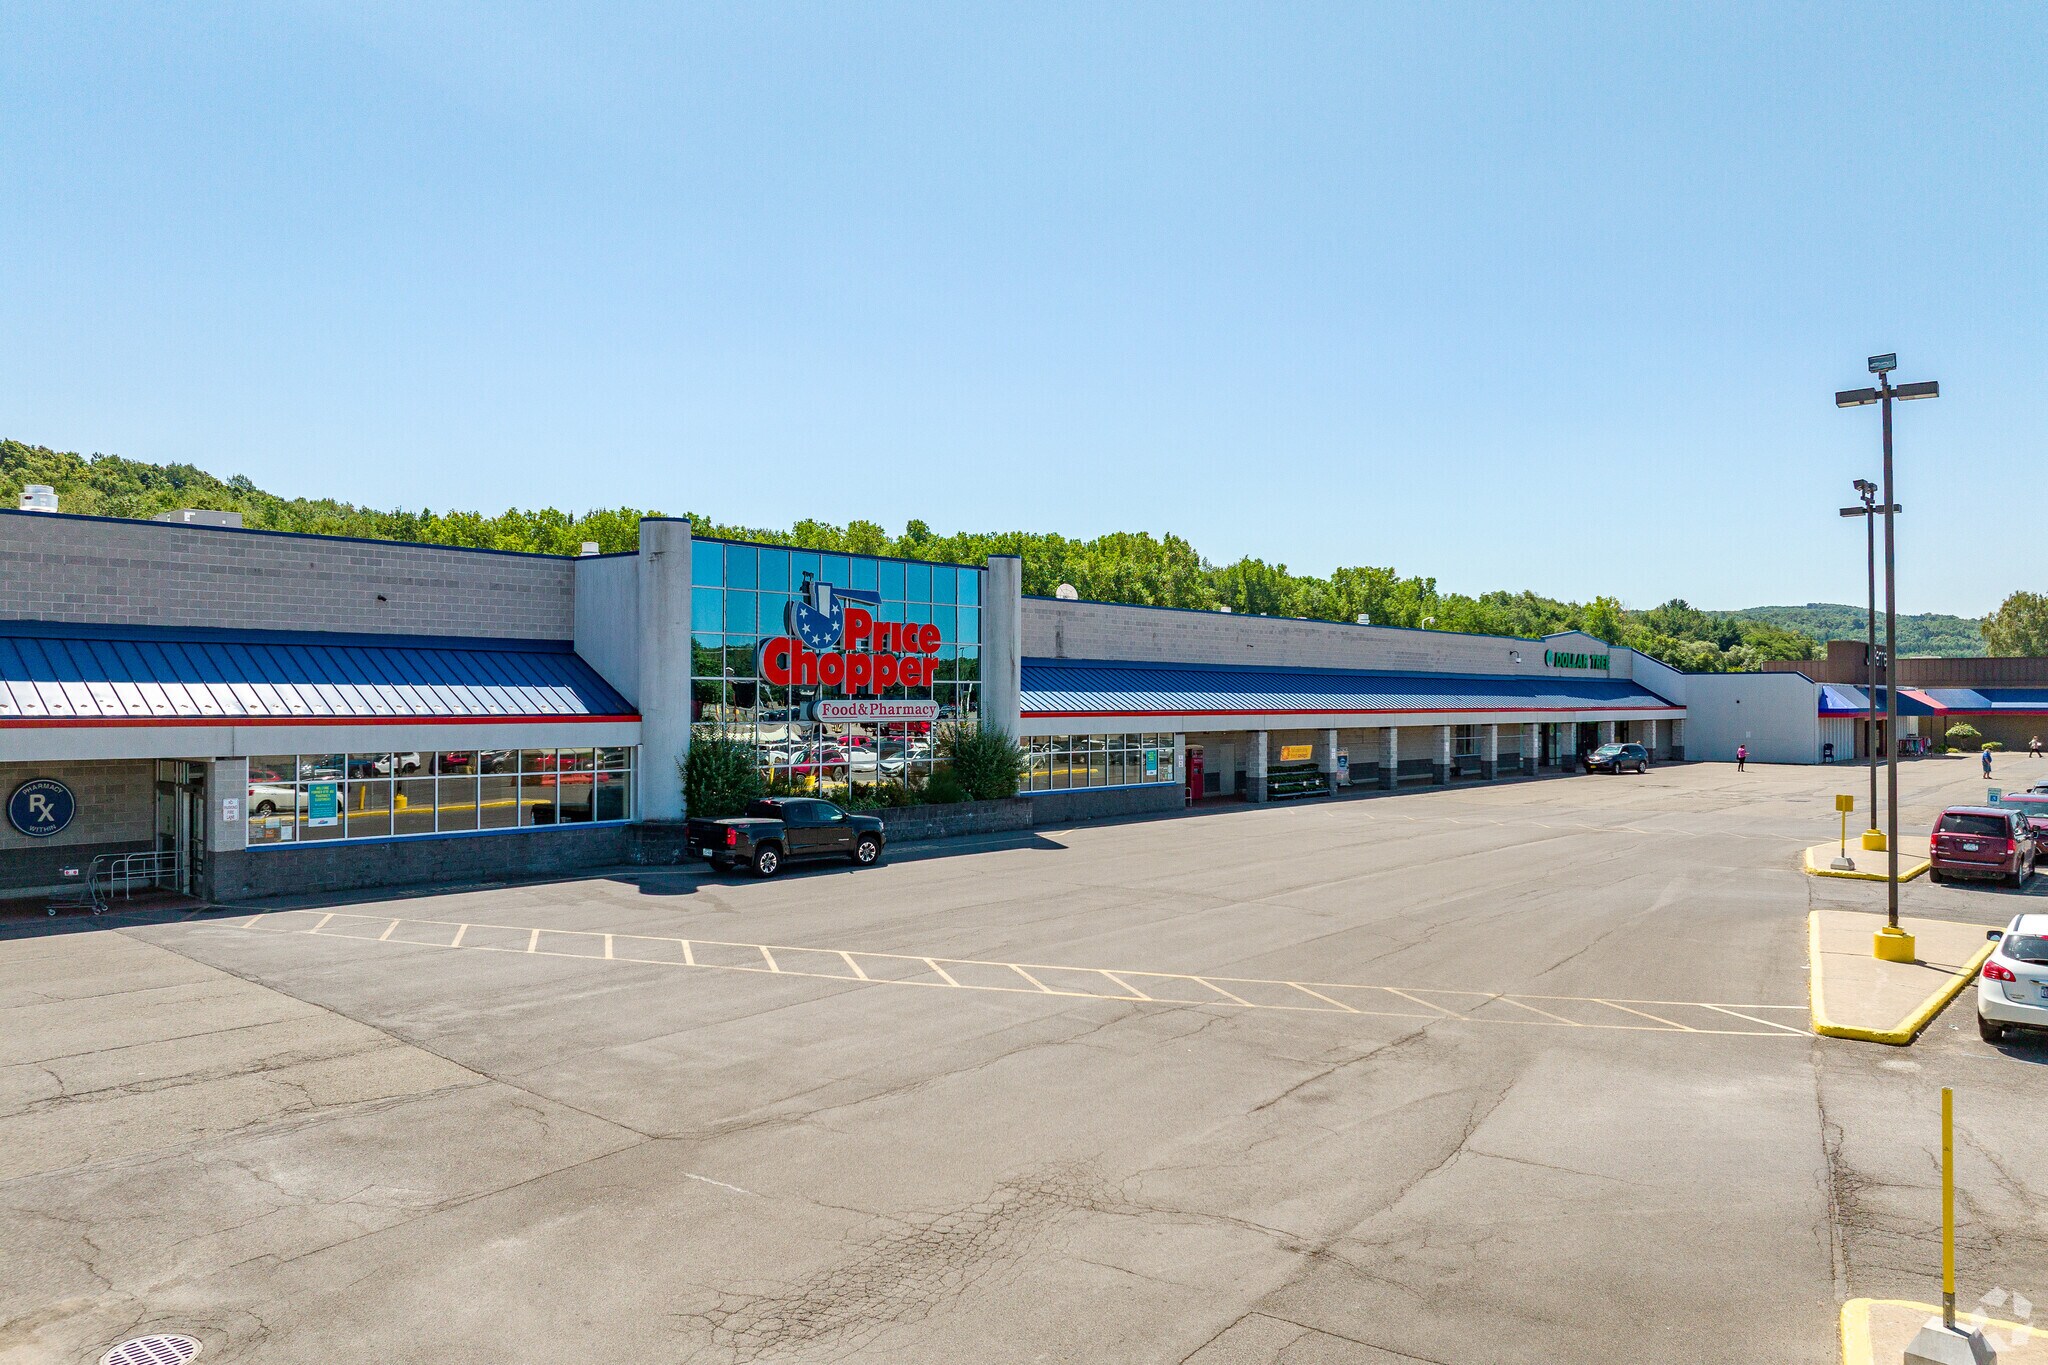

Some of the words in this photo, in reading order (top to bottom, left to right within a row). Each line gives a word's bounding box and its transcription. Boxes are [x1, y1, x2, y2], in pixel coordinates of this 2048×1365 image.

[843, 607, 941, 654] Price
[762, 636, 940, 695] Chopper
[1554, 652, 1588, 669] DOLLAR
[1590, 654, 1610, 670] TREE
[22, 783, 64, 796] PHARMACY
[29, 823, 57, 833] WITHIN
